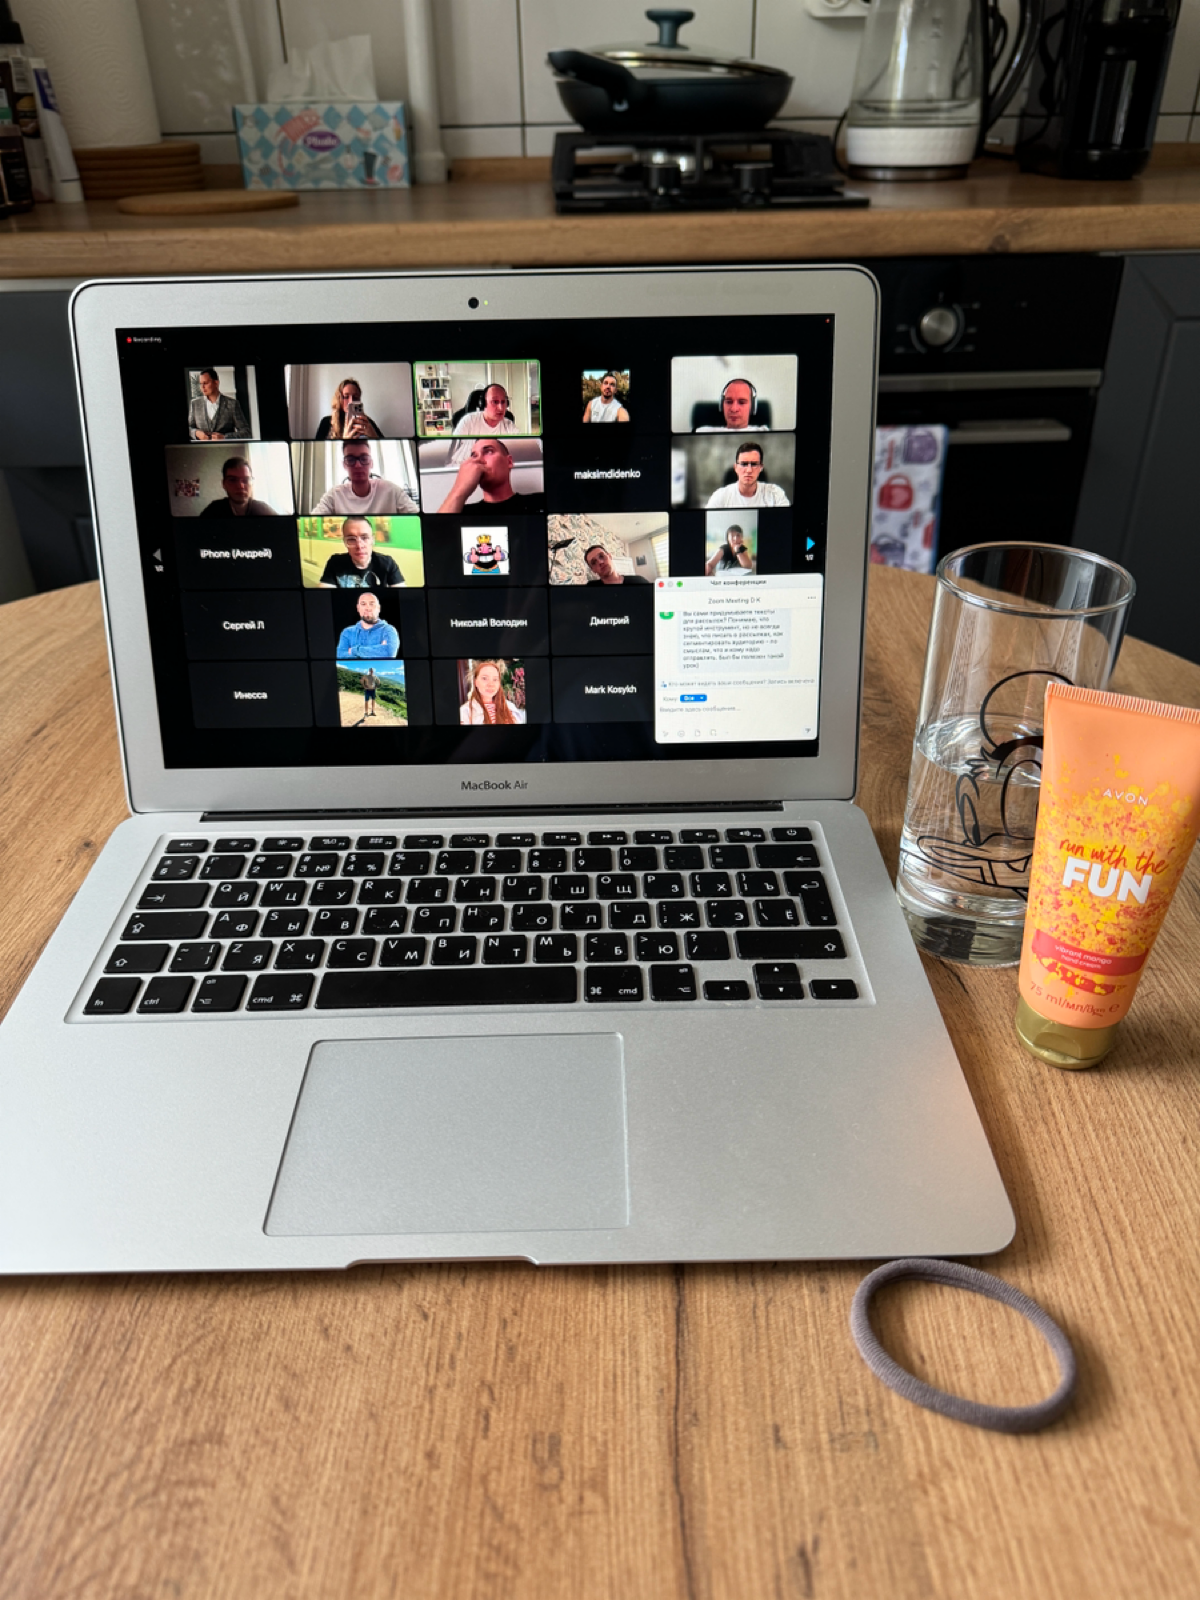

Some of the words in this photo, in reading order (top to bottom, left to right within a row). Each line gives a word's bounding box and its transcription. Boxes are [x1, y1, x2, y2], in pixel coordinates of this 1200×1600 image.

[574, 469, 641, 480] maksimdidenko
[200, 549, 230, 559] iPhone
[232, 548, 273, 560] (Андрей)
[450, 618, 488, 628] Николай
[490, 618, 528, 628] Володин
[589, 615, 630, 627] Дмитрий
[222, 620, 256, 631] Сергей
[257, 620, 265, 630] Л
[584, 685, 606, 695] Mark
[607, 684, 637, 695] Kosykh
[233, 691, 268, 700] Инесса
[460, 780, 512, 790] MacBook
[513, 780, 529, 790] Air
[1102, 787, 1149, 806] AVON
[1059, 838, 1085, 857] run
[1090, 844, 1127, 870] with
[1135, 850, 1170, 876] the
[414, 880, 420, 888] T
[1061, 855, 1153, 905] FUN
[219, 883, 232, 892] Q
[270, 883, 283, 891] W
[315, 881, 324, 889] E
[365, 881, 373, 889] R
[617, 885, 631, 893] Щ
[529, 887, 536, 895] Г
[237, 892, 249, 901] Й
[285, 893, 296, 901] Ц
[320, 911, 330, 919] D
[369, 909, 377, 917] F
[420, 909, 429, 917] G
[517, 907, 523, 915] J
[785, 909, 794, 920] Ё
[219, 912, 230, 922] A
[268, 912, 279, 921] S
[587, 915, 596, 923] Л
[633, 915, 645, 923] Д
[680, 913, 694, 921] Ж
[288, 923, 300, 931] Ы
[440, 919, 449, 927] П
[388, 940, 398, 949] V
[439, 939, 447, 947] B
[489, 938, 499, 946] N
[540, 937, 552, 945] M
[231, 943, 243, 952] Z
[283, 942, 295, 952] X
[336, 941, 346, 950] C
[659, 945, 673, 953] Ю
[459, 950, 469, 958] И
[564, 948, 571, 956] Ь
[615, 947, 623, 955] Б
[1054, 944, 1083, 959] vibrant
[1083, 953, 1113, 965] mango
[253, 955, 263, 963] Я
[1060, 954, 1079, 965] hand
[1078, 960, 1102, 969] cream
[1029, 980, 1044, 997] 75
[143, 997, 160, 1005] ctrl
